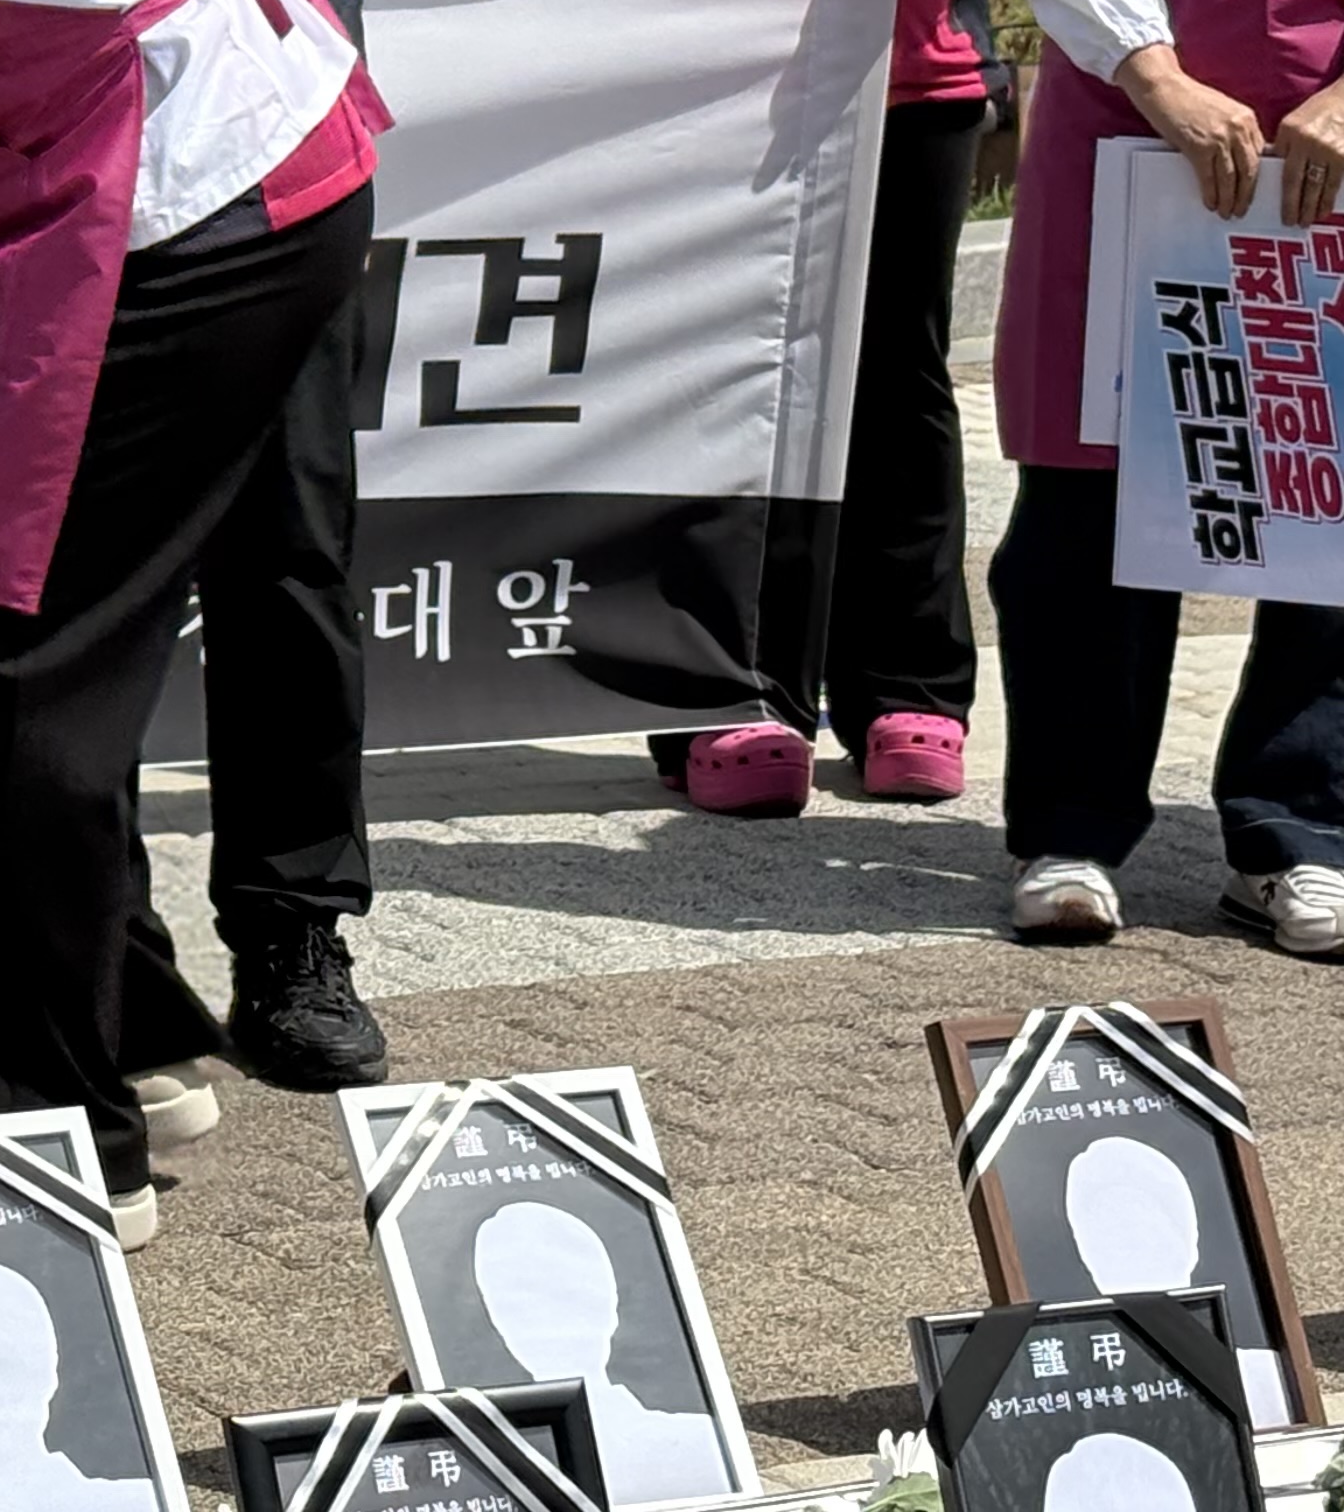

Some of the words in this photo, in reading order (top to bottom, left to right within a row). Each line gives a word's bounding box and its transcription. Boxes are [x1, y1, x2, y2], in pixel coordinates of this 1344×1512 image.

[364, 233, 604, 431] 견
[1153, 281, 1265, 563] 학교급식
[1228, 234, 1343, 521] 종합대책
[496, 559, 591, 659] 앞
[986, 1391, 1072, 1420] 삼가고인의
[1076, 1385, 1128, 1409] 명복을
